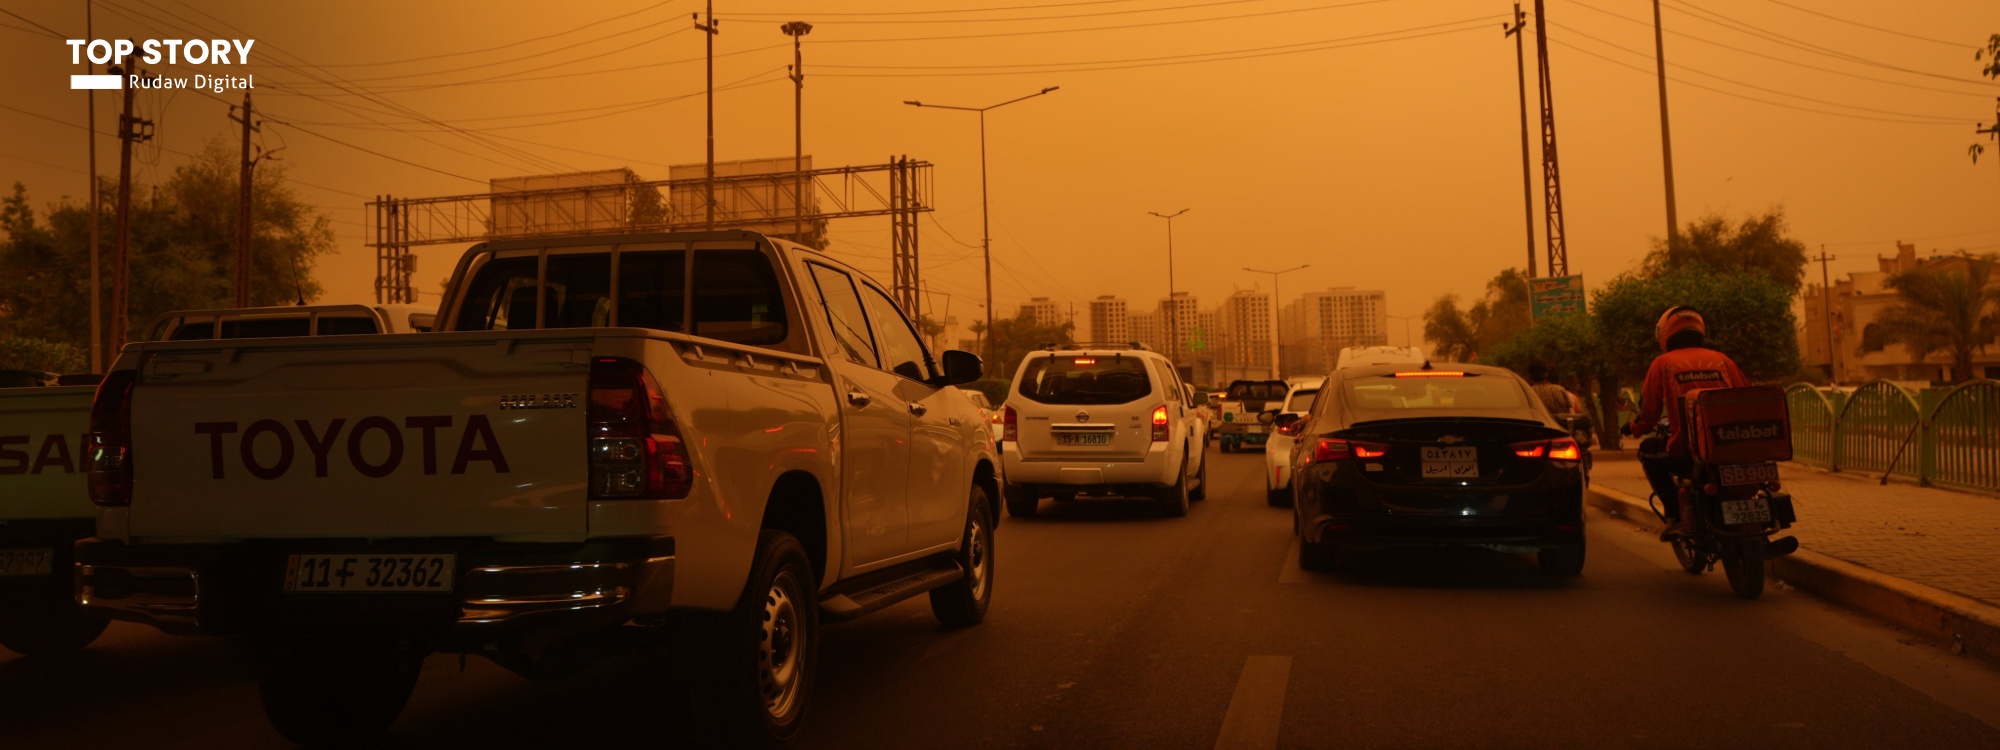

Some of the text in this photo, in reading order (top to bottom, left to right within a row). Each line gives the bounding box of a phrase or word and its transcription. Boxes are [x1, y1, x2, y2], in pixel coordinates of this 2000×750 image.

[1678, 372, 1720, 381] talabat
[500, 394, 578, 410] HILUX
[1083, 434, 1107, 444] 16810
[1716, 423, 1778, 441] talabat
[0, 433, 89, 474] SA
[195, 414, 511, 480] TOYOTA
[1723, 465, 1776, 483] SB 900
[1736, 501, 1750, 511] 11
[1733, 510, 1769, 522] 92835
[366, 558, 444, 587] 32362
